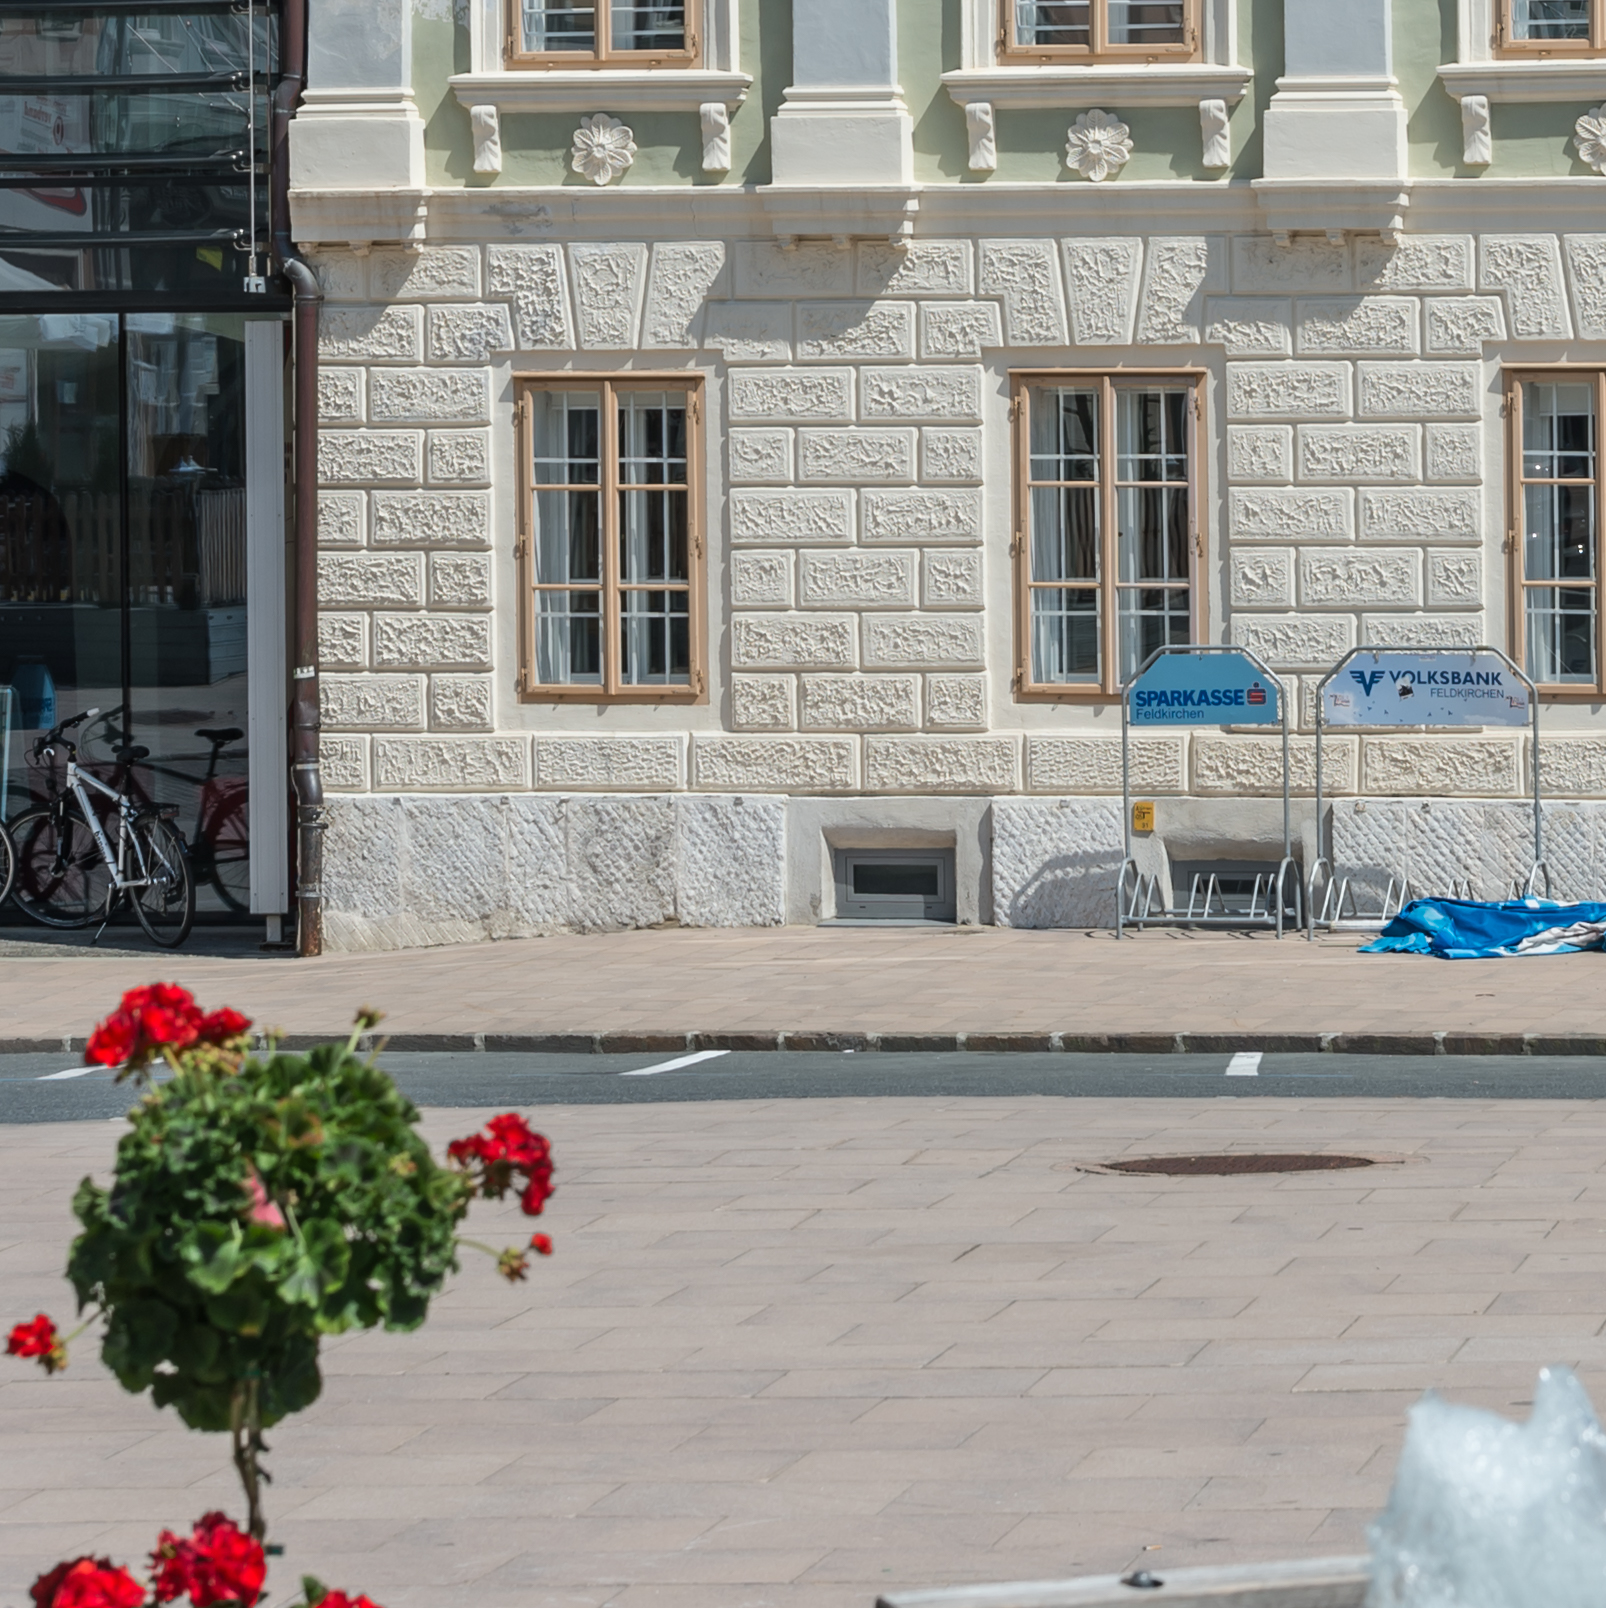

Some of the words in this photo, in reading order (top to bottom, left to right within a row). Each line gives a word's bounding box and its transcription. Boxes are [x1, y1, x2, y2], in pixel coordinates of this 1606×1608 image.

[1389, 670, 1503, 685] VOLKSBANK
[1136, 689, 1245, 707] SPARKASSE
[1430, 688, 1504, 699] FELDKIRCHEN
[1136, 708, 1205, 720] Feldkirchen
